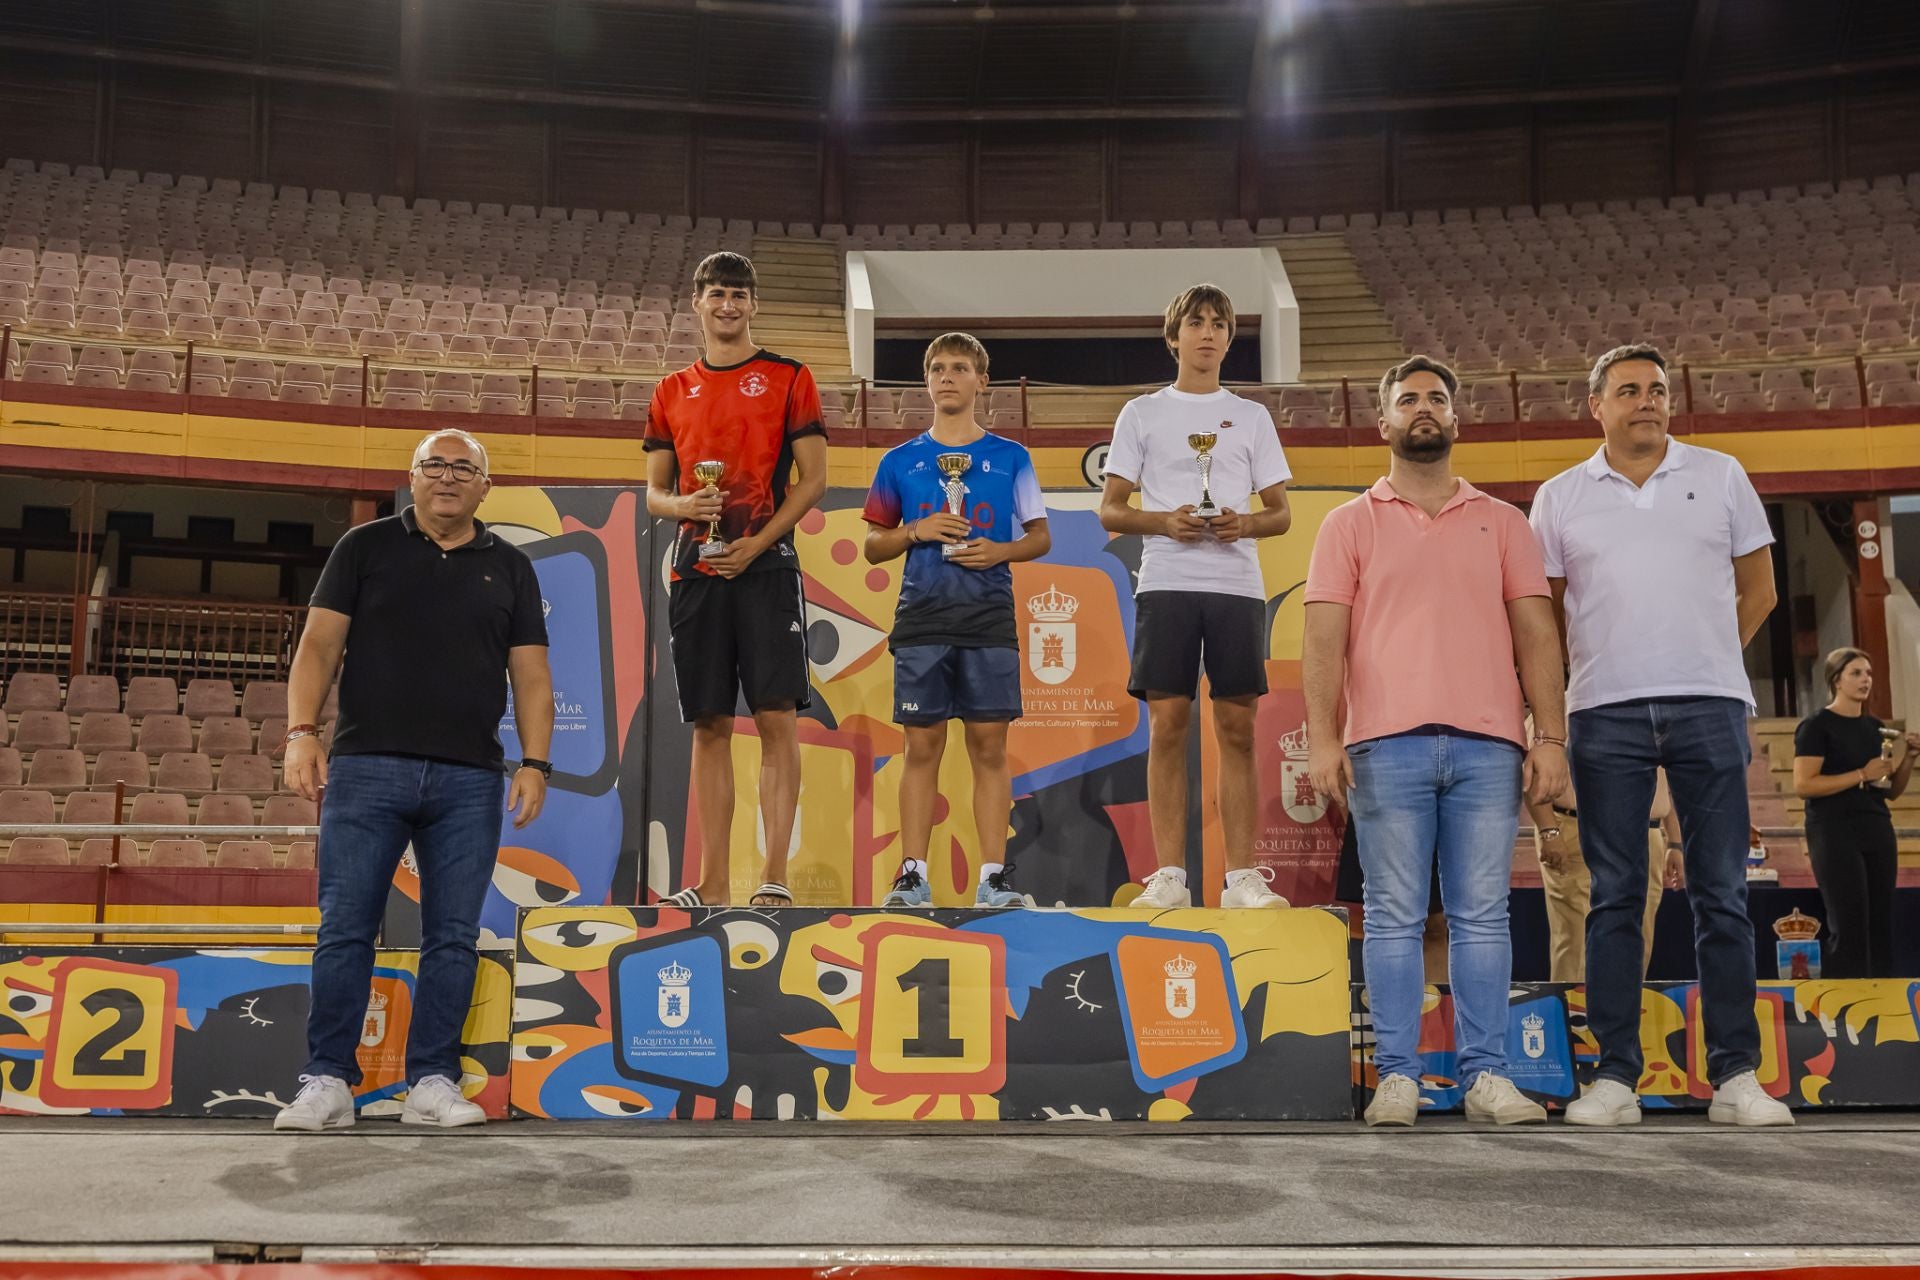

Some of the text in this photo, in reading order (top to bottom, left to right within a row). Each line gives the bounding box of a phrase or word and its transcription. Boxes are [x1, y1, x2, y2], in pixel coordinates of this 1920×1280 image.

[1021, 687, 1095, 696] UNTAMIENTO DE
[902, 702, 919, 711] FILA
[1022, 698, 1115, 711] UETAS DE MAR
[554, 723, 587, 731] mpo Libre
[1014, 720, 1046, 728] Deportes,
[1076, 720, 1102, 728] Tiempo
[1265, 827, 1333, 835] AYUNTAMIENTO
[1254, 839, 1311, 852] OQUETAS
[1316, 839, 1332, 850] DE
[896, 958, 964, 1058] 1
[72, 987, 147, 1077] 2
[633, 1036, 676, 1047] ROQUETAS
[679, 1038, 690, 1046] DE
